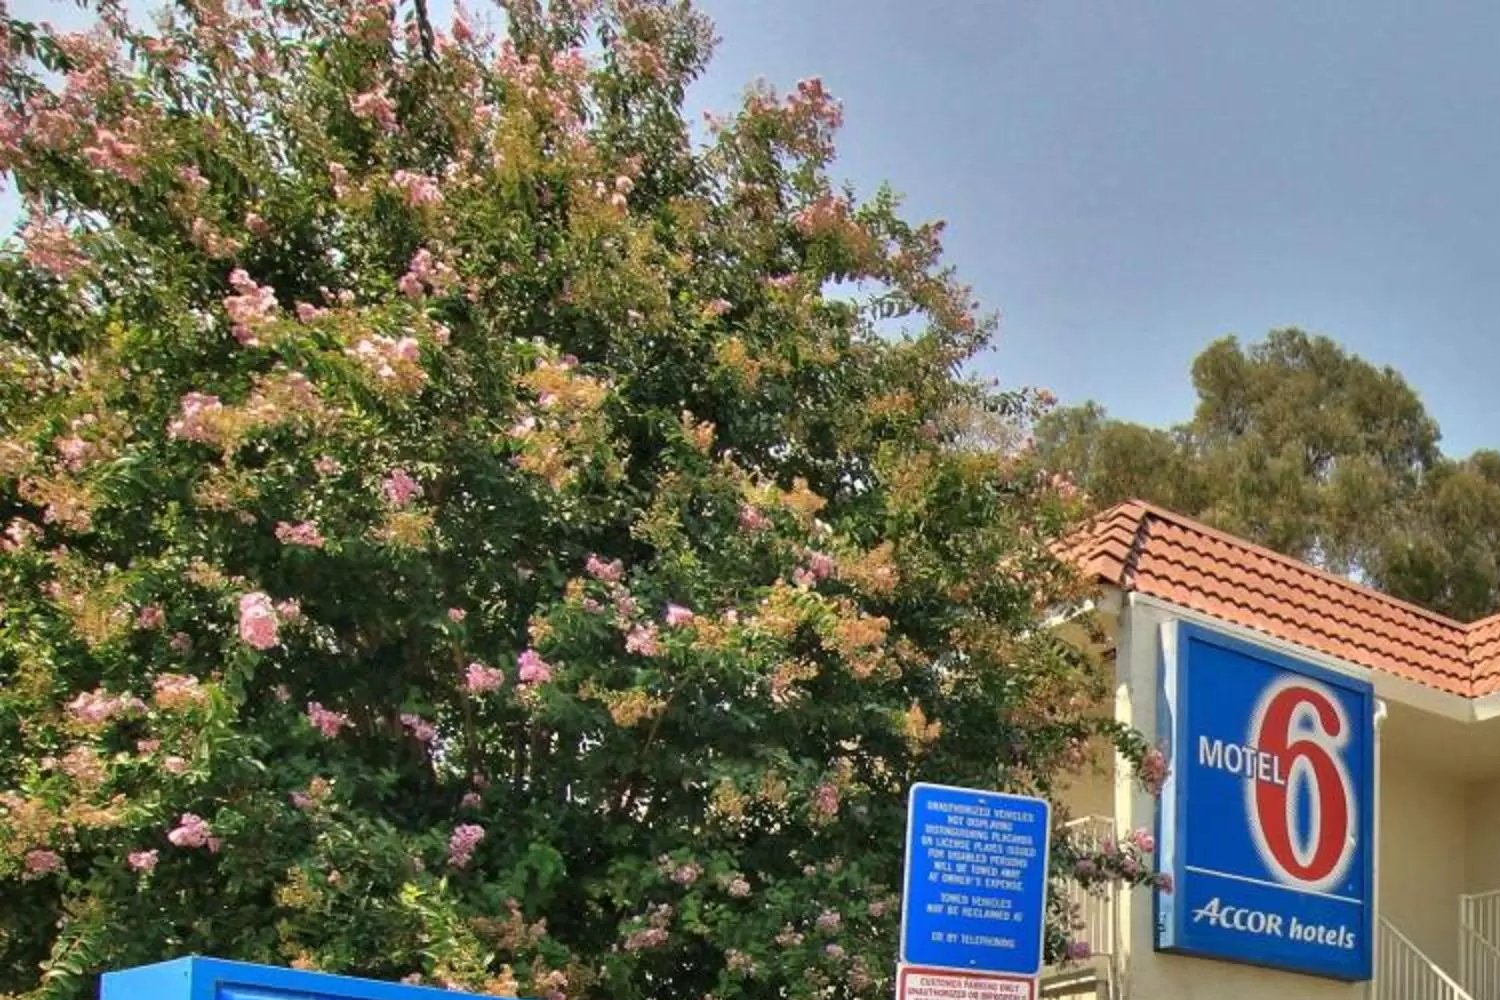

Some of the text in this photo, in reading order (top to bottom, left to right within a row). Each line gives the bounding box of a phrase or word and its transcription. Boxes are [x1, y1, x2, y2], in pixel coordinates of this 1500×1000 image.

[1199, 684, 1349, 883] MOTEL 6
[1288, 917, 1355, 949] hotels
